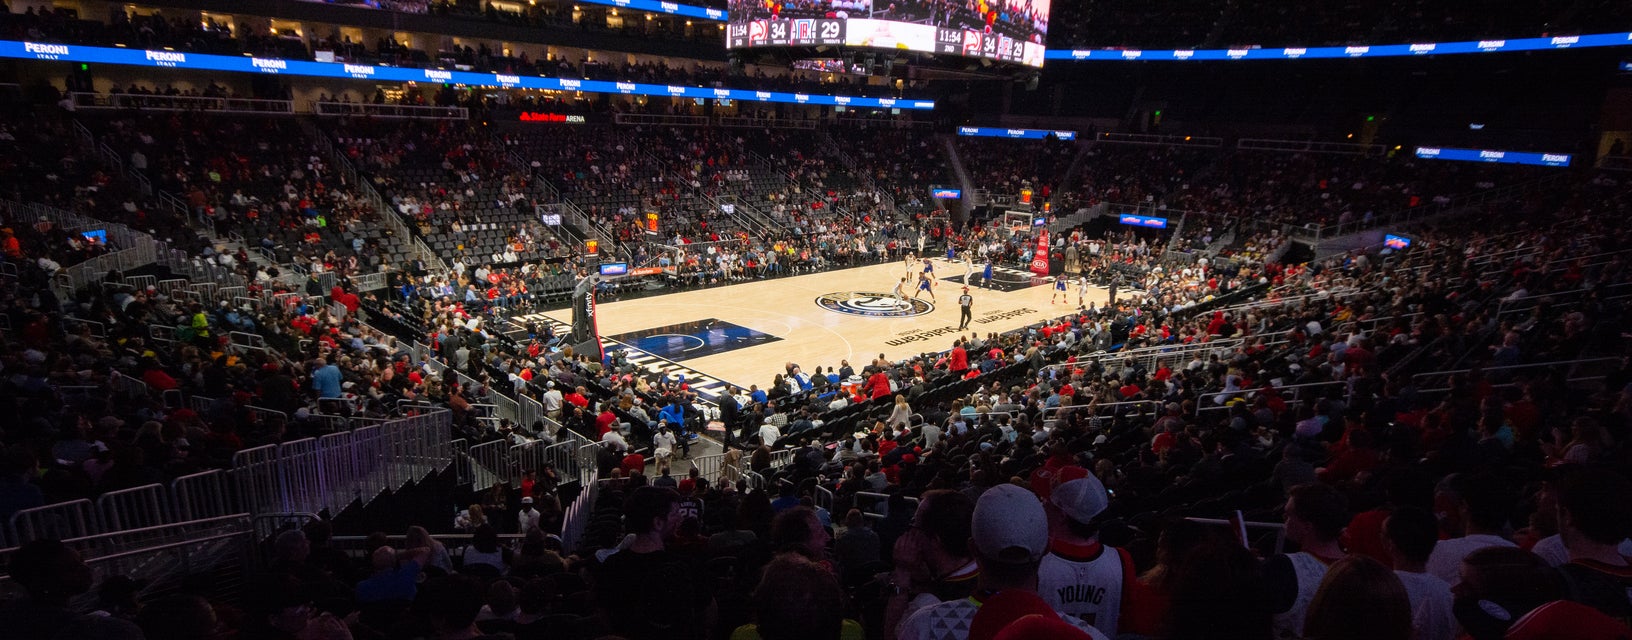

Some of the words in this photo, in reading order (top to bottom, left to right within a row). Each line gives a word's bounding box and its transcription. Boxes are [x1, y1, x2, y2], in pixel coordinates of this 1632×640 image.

[732, 25, 747, 37] 11:54
[771, 23, 786, 38] 34
[821, 22, 840, 39] 29
[940, 30, 961, 44] 11:54
[24, 42, 69, 55] PERONI
[984, 37, 996, 52] 34
[1013, 42, 1023, 57] 29
[145, 50, 186, 62] PERONI
[252, 57, 287, 69] PERONI
[344, 64, 375, 75] PERONI
[424, 69, 452, 80] PERONI
[496, 74, 521, 84] PERONI
[559, 78, 581, 87] PERONI
[616, 82, 636, 91] PERONI
[531, 112, 549, 121] State
[1416, 147, 1441, 156] PERONI
[1480, 150, 1505, 159] PERONI
[1542, 153, 1568, 163] PERONI
[585, 291, 594, 317] xfinity
[1057, 584, 1106, 605] YOUNG
